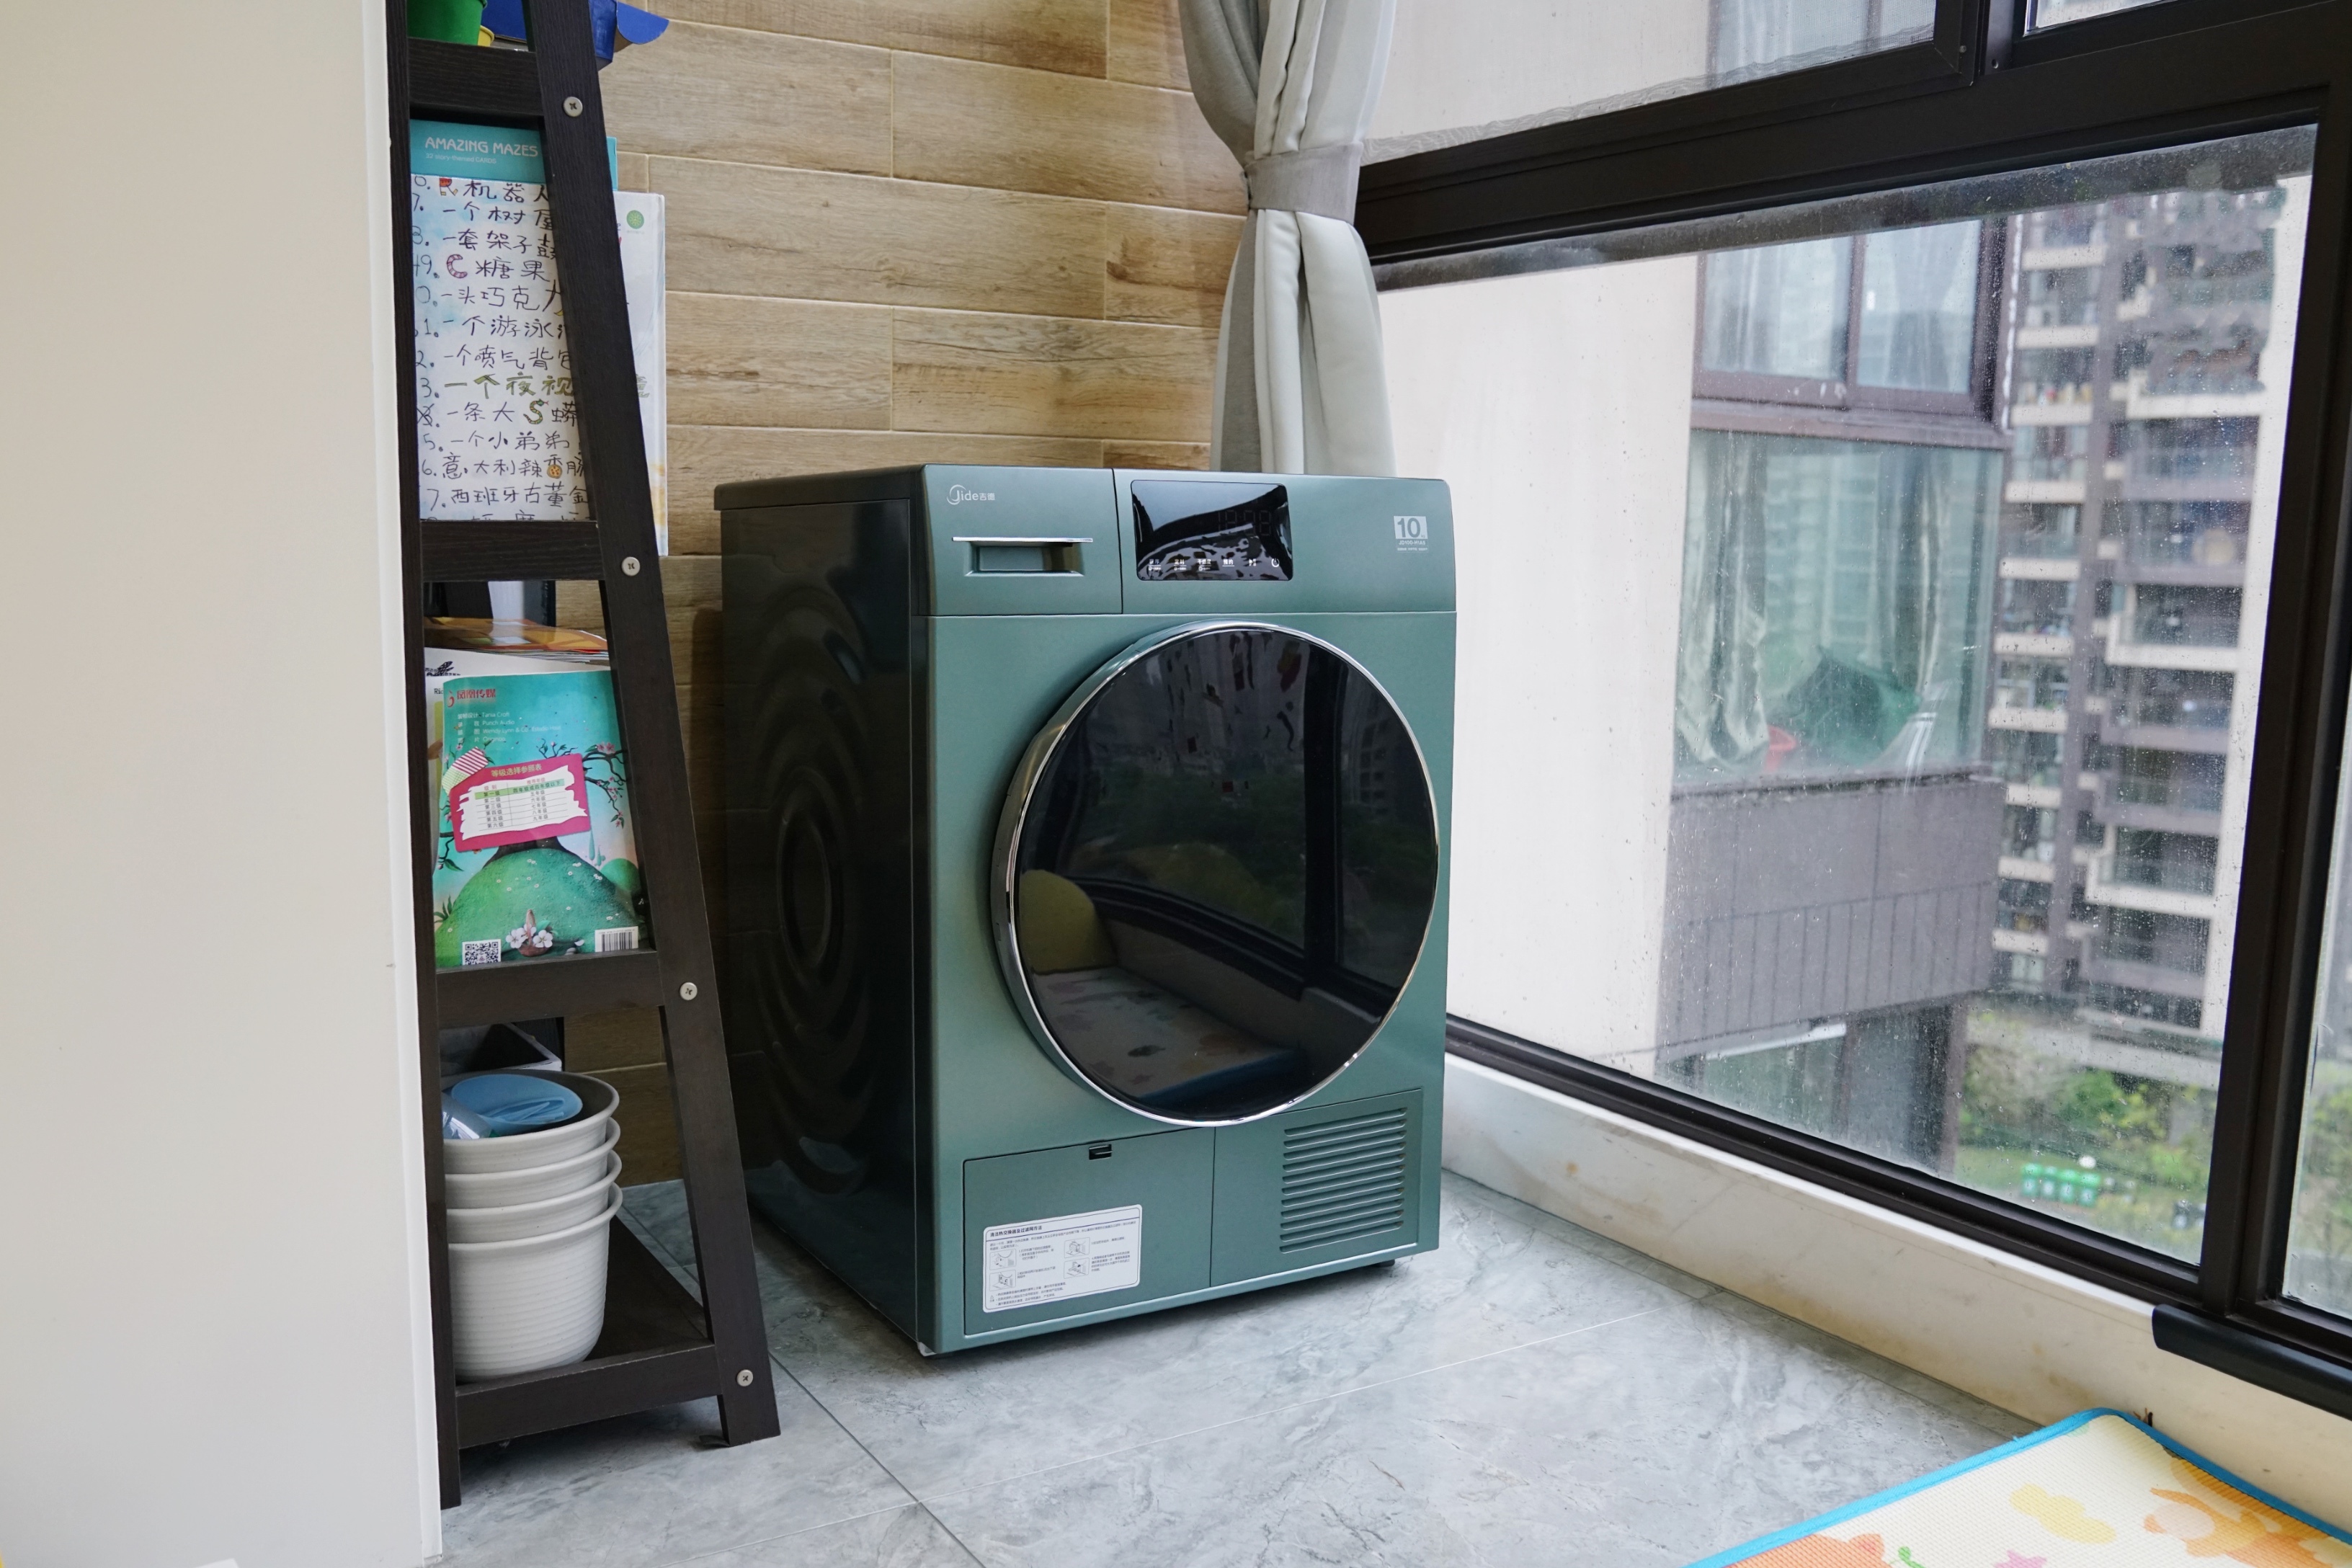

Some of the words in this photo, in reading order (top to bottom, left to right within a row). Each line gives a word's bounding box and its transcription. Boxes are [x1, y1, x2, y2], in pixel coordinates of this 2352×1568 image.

[424, 136, 489, 153] AMAZING
[492, 143, 538, 157] MAZES
[1396, 517, 1421, 538] 10
[491, 764, 542, 777] 等级选择参照表
[990, 1226, 1043, 1237] 清洁热交换器及过滤网方法
